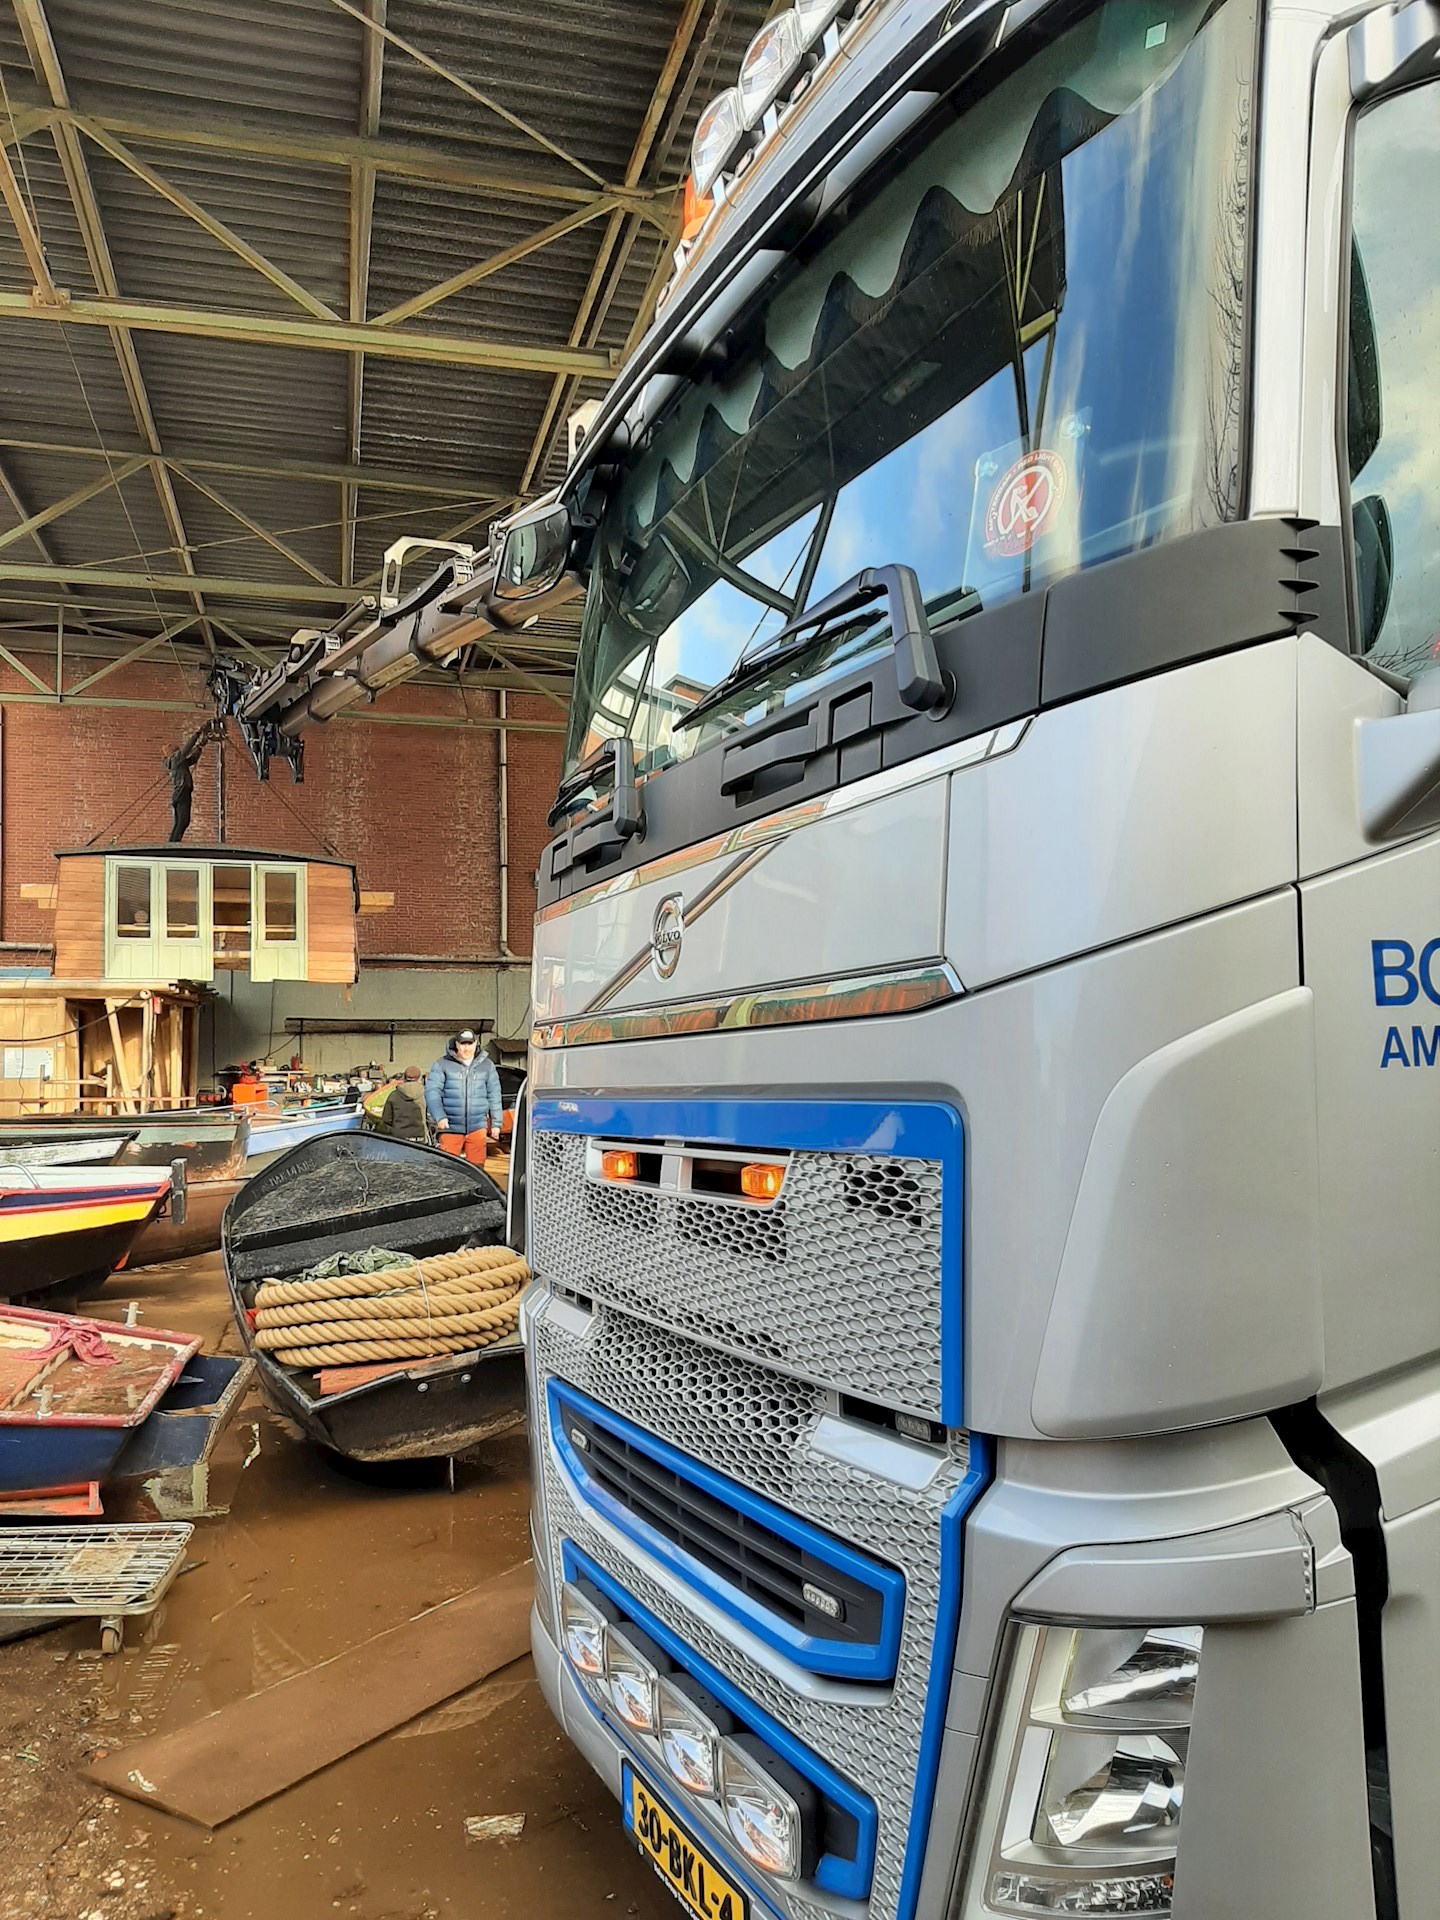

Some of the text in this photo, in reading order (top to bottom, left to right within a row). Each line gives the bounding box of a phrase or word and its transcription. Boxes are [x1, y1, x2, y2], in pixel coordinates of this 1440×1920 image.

[1017, 456, 1034, 469] RED
[1035, 452, 1055, 462] LIGHT
[654, 930, 681, 945] VOLVO
[1380, 1025, 1440, 1069] AM
[638, 1791, 733, 1920] 30-BKL-4
